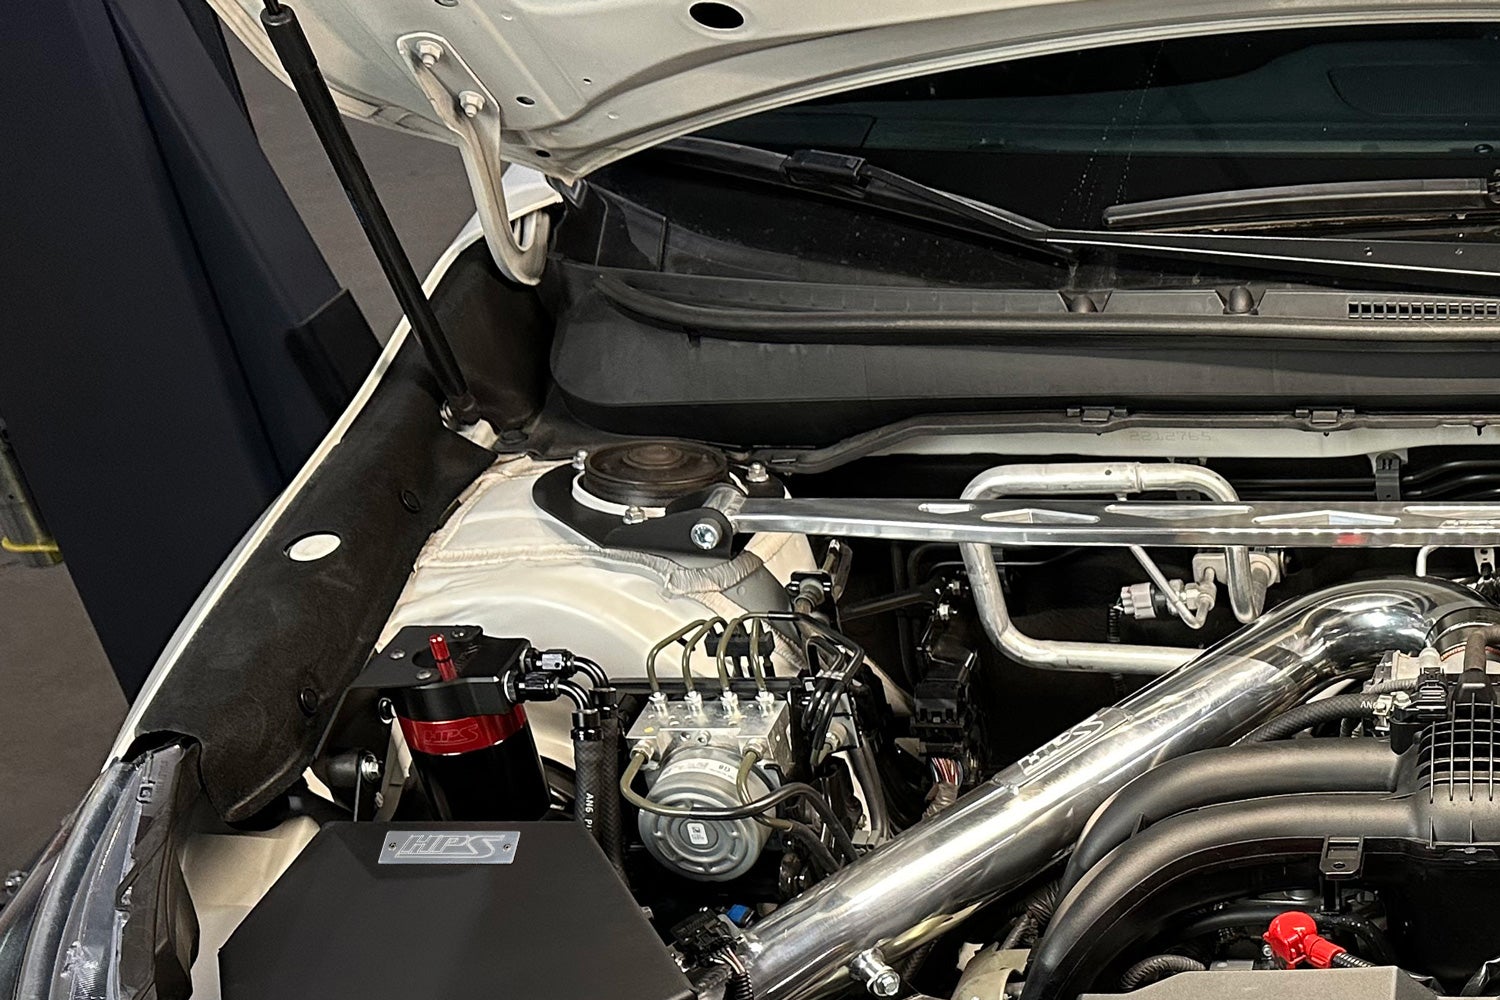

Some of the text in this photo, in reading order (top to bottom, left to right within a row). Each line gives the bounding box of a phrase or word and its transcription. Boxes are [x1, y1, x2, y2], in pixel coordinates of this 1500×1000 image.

[423, 723, 479, 746] HPS
[1017, 714, 1104, 776] HPS
[584, 792, 594, 813] AN6
[394, 834, 505, 859] HPS
